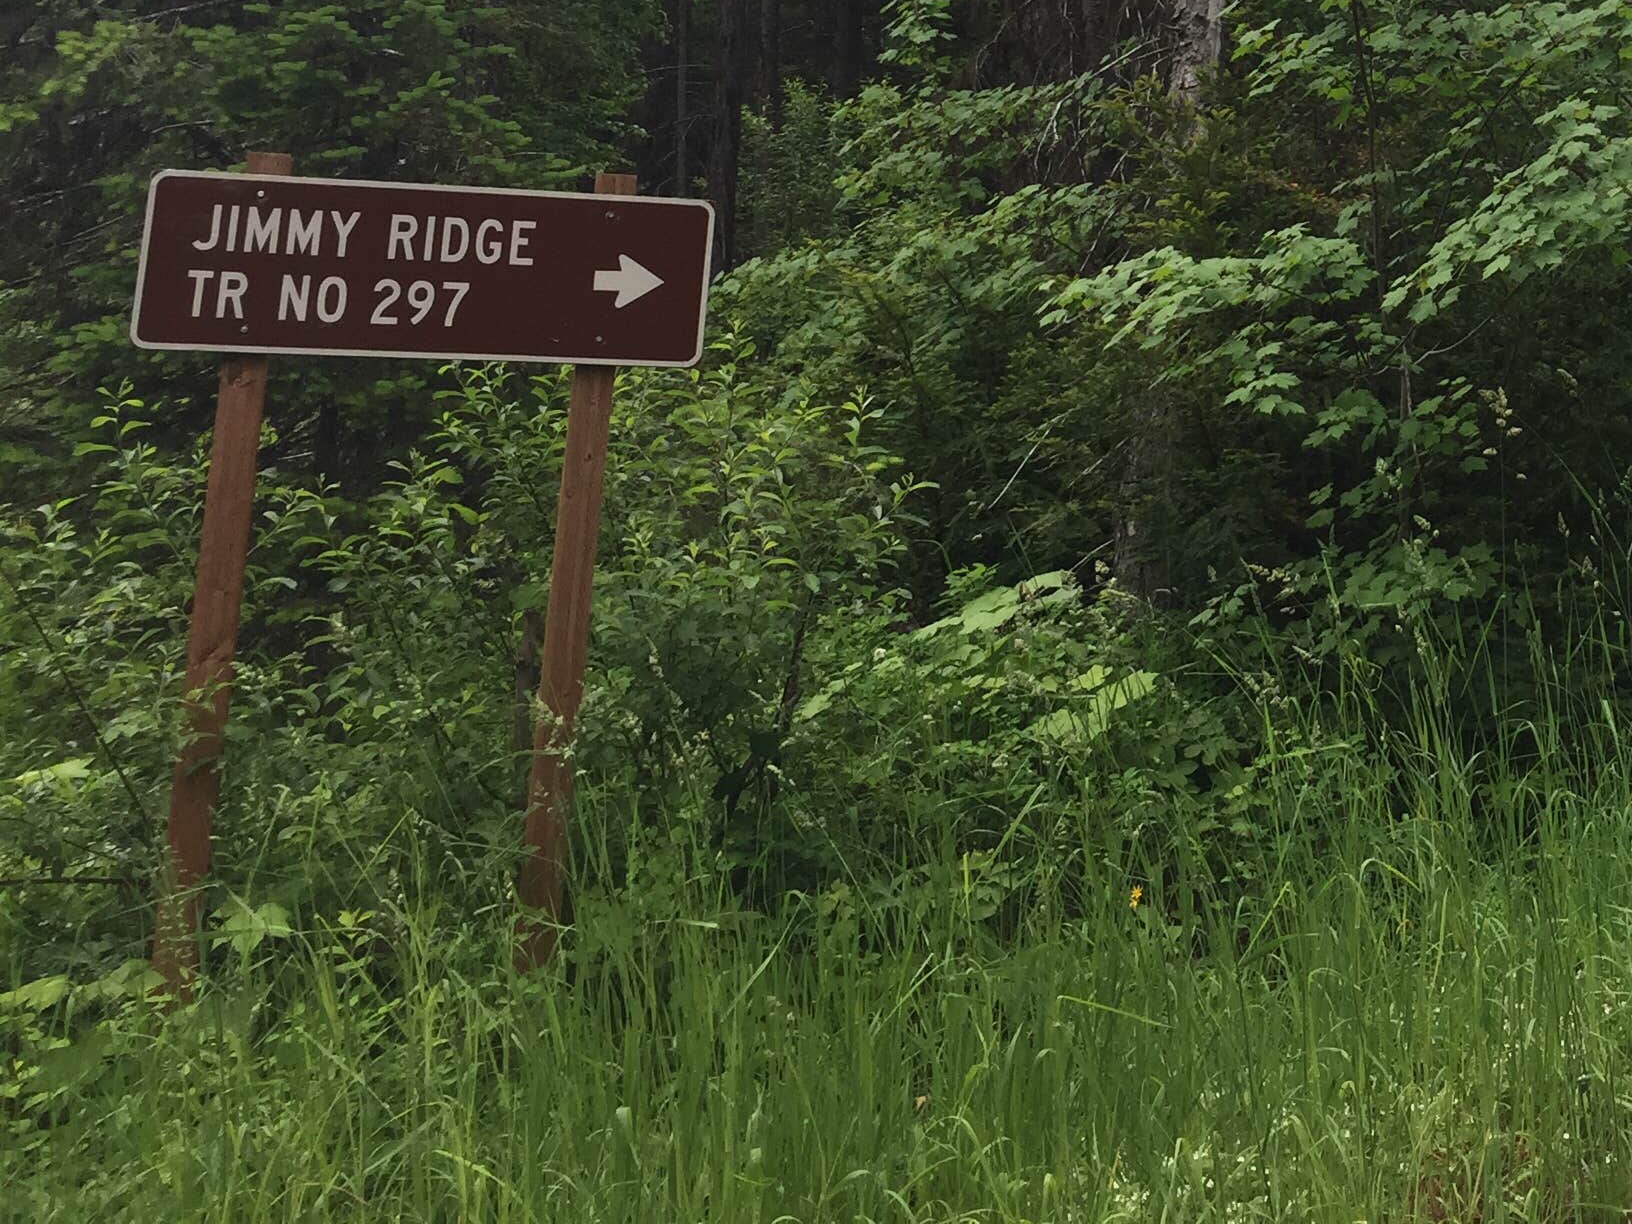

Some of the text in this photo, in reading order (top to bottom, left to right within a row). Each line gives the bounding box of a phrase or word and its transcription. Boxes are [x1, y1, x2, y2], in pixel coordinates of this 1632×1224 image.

[192, 205, 536, 265] JIMMY RIDGE
[188, 270, 469, 326] TR NO 297
